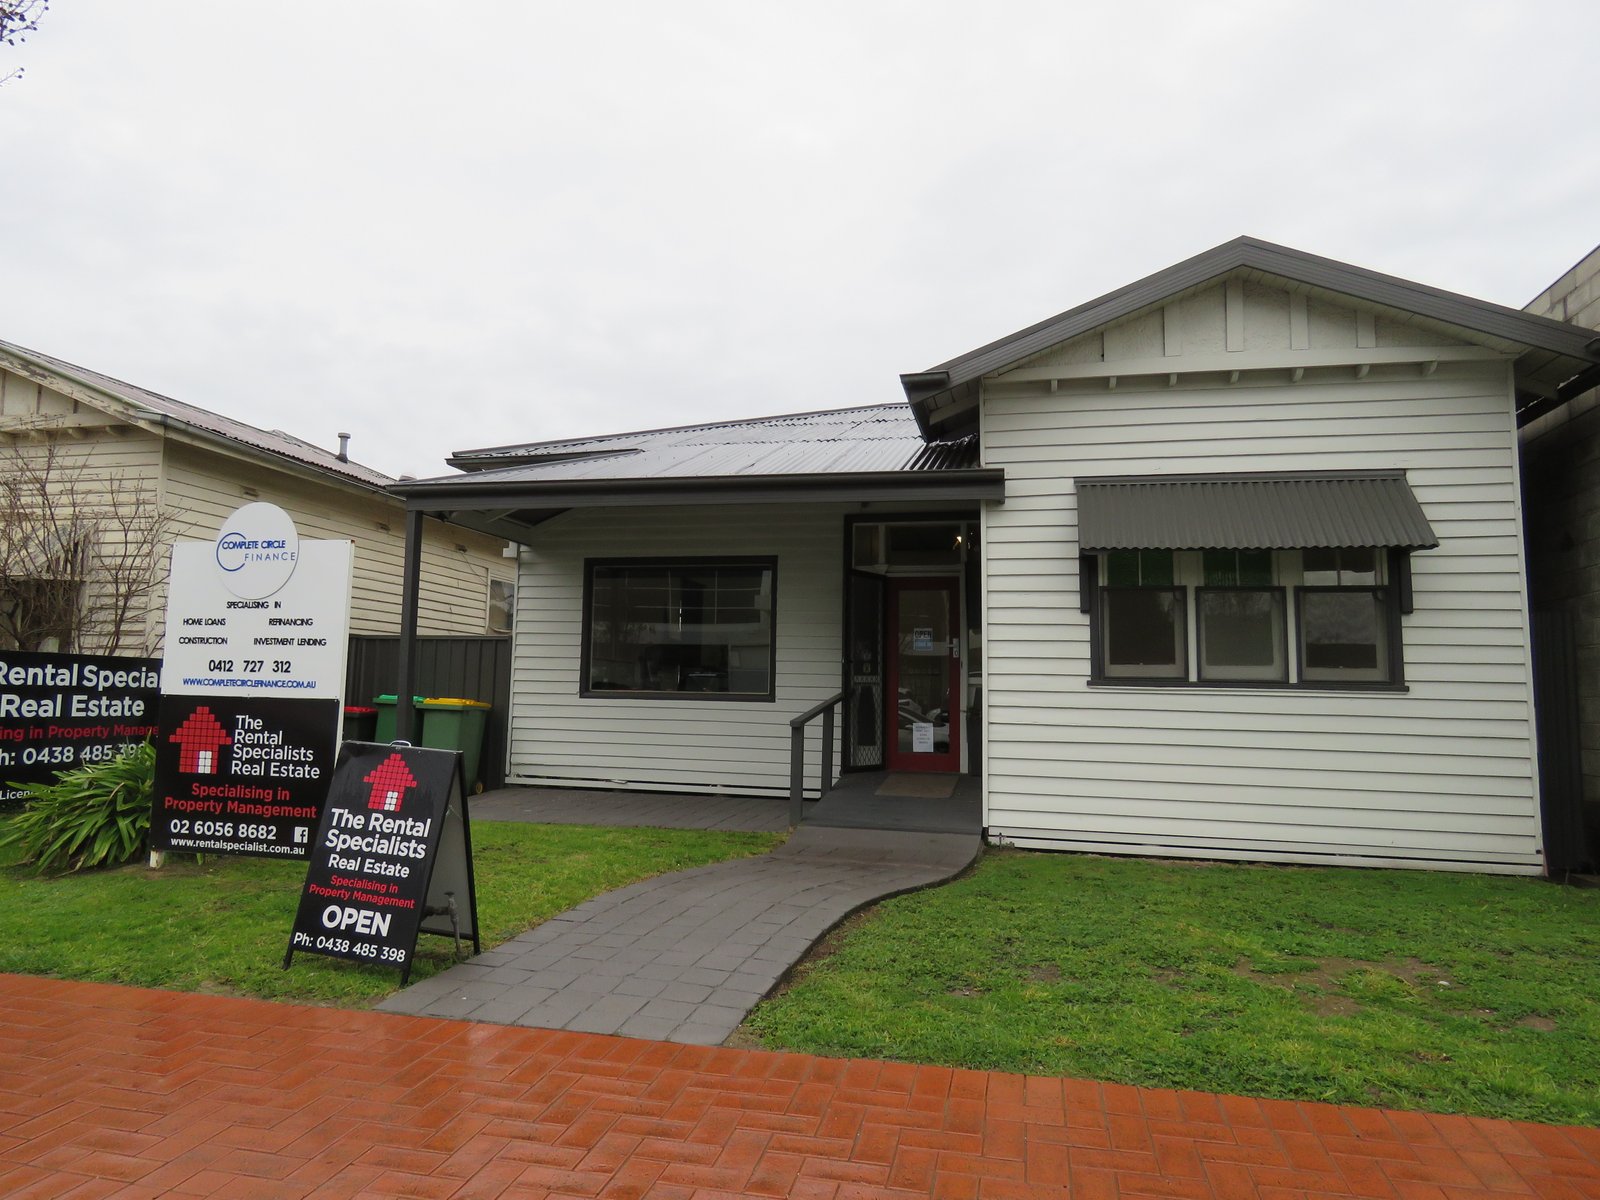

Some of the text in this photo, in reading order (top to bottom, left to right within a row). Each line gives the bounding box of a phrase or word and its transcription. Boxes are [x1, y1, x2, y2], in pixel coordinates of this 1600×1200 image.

[222, 540, 286, 550] COMPLETE CIRCLE
[244, 552, 296, 562] FINANCE
[226, 601, 269, 609] SPECIALISING
[183, 618, 226, 626] HOME LOANS
[268, 618, 314, 626] REFINANCING
[178, 637, 228, 645] CONSTRUCTION
[253, 638, 327, 647] INVESTMENT LENDING
[915, 630, 932, 639] OPEN
[0, 661, 79, 686] Rental
[208, 660, 291, 673] 0412 727 312
[0, 694, 145, 718] Real Estate
[236, 715, 263, 730] The
[29, 726, 43, 739] in
[48, 725, 110, 740] Property
[234, 729, 283, 744] Rental
[22, 746, 74, 765] 0438
[80, 744, 113, 761] 485
[233, 744, 314, 761] Specialists
[231, 760, 320, 779] Real Estate
[191, 783, 290, 802] Specialising in
[164, 797, 317, 818] Property Management
[170, 819, 190, 833] 02
[194, 821, 234, 837] 6056
[238, 824, 277, 840] 8682
[331, 808, 431, 838] The Rental
[171, 838, 305, 855] www.rentalspecialist.com.au
[325, 829, 427, 859] Specialists
[328, 854, 410, 878] Real Estate
[330, 875, 399, 894] Specialising in
[309, 884, 416, 909] Property Management
[322, 904, 392, 937] OPEN
[293, 932, 406, 962] Ph: 0438 485 398
